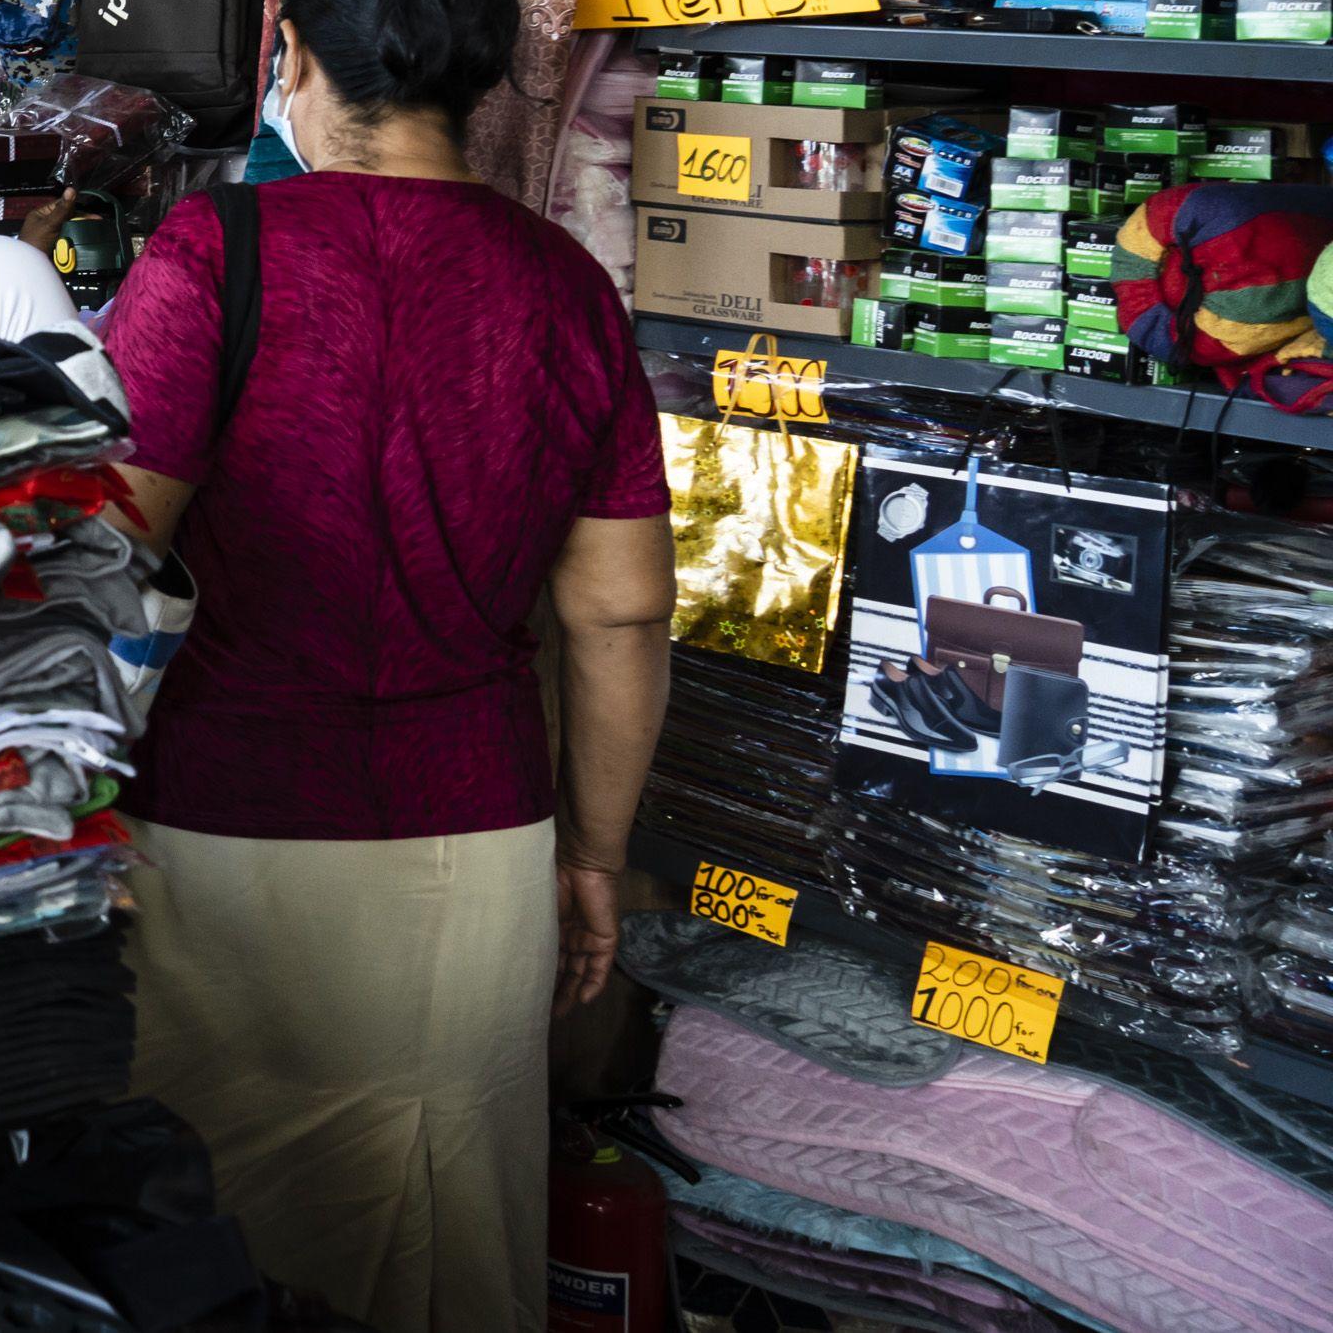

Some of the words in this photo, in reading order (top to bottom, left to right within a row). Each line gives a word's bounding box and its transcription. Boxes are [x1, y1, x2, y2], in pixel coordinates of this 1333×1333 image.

[1155, 3, 1197, 13] ROCKET
[1267, 1, 1322, 11] ROCKET
[664, 69, 696, 79] ROCKET
[1132, 115, 1165, 124] ROCKET
[1016, 126, 1054, 135] ROCKET
[1215, 144, 1261, 154] ROCKET
[681, 148, 747, 184] 1600
[893, 165, 914, 178] AA
[1016, 175, 1061, 185] ROCKET
[895, 222, 916, 235] AA
[1009, 226, 1053, 237] ROCKET
[1076, 241, 1115, 252] ROCKET
[963, 273, 986, 283] ROC
[1041, 270, 1057, 278] AAA
[1009, 278, 1052, 289] ROCKET
[720, 293, 762, 312] DELI
[1077, 294, 1113, 305] ROCKET
[692, 304, 764, 323] GLASSWARE
[1045, 323, 1061, 331] AAA
[1013, 330, 1058, 342] ROCKET
[1069, 348, 1111, 362] ROCKET
[695, 865, 755, 901] 100
[695, 891, 750, 929] 800
[922, 946, 1011, 995] 200
[912, 986, 1014, 1046] 1000
[1014, 1021, 1035, 1037] for
[548, 1269, 617, 1296] WDER
